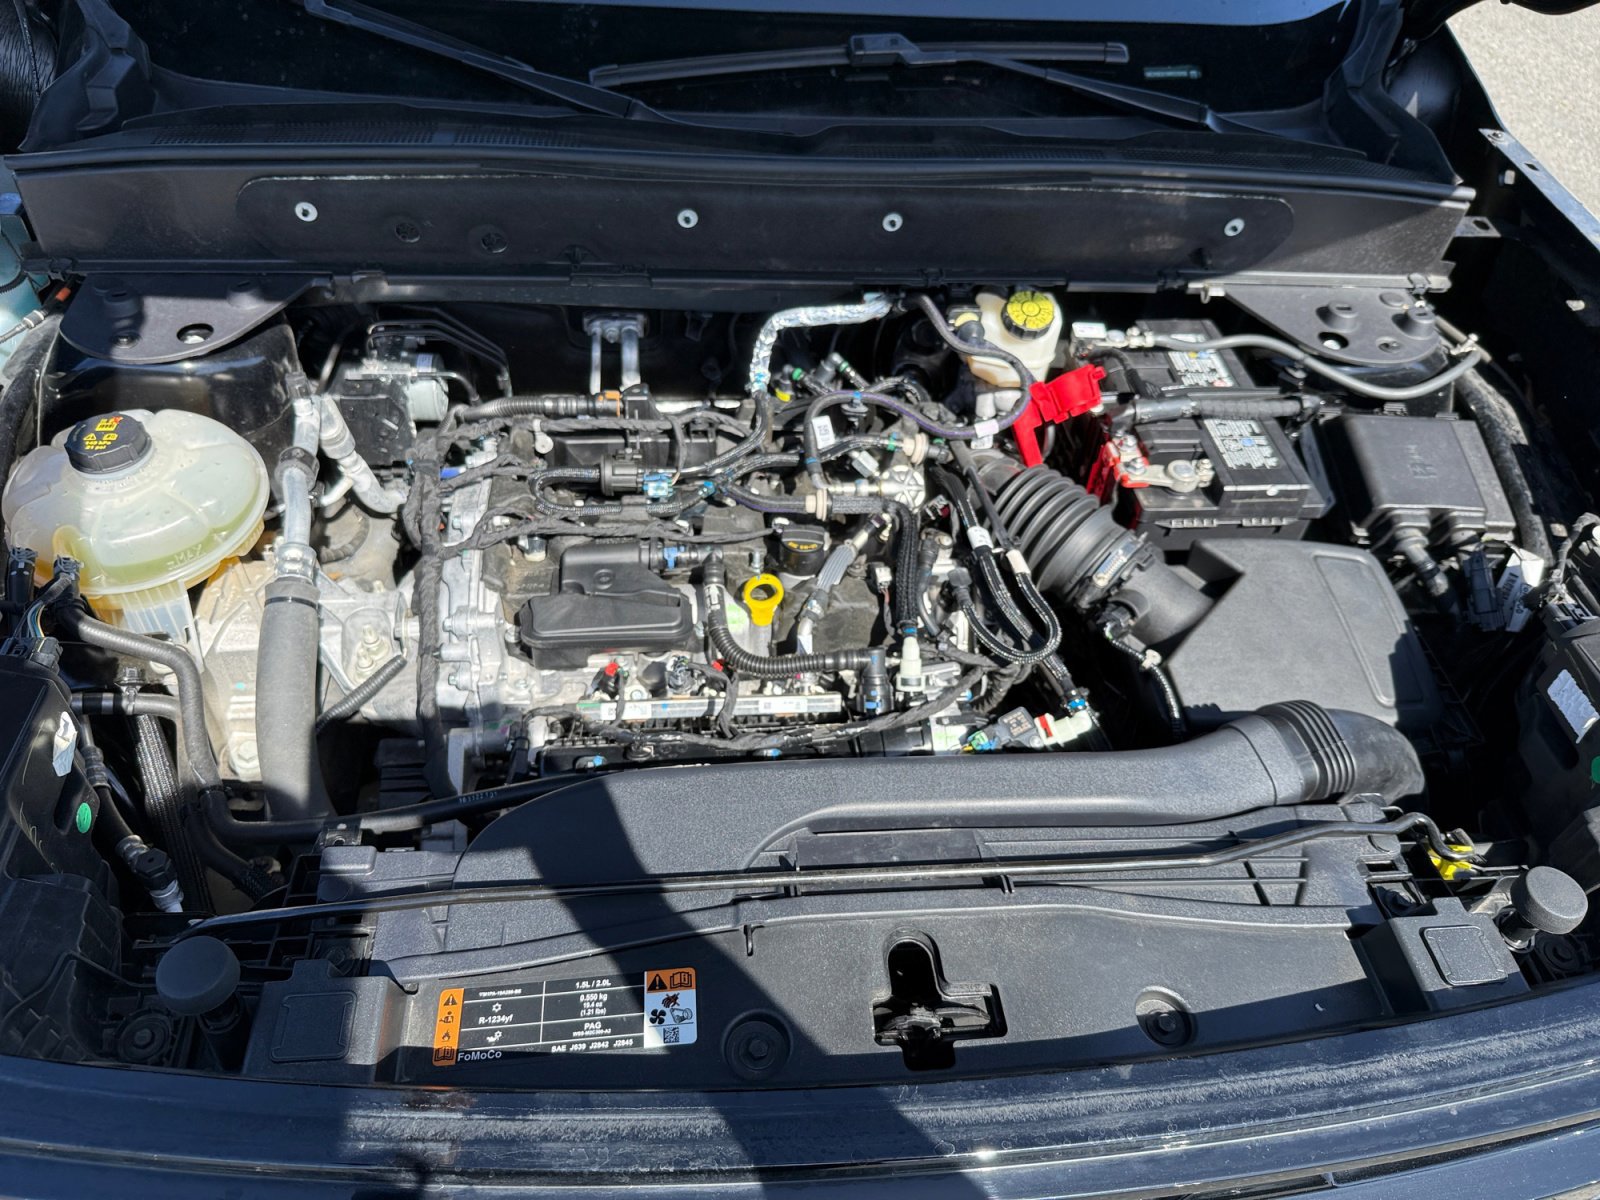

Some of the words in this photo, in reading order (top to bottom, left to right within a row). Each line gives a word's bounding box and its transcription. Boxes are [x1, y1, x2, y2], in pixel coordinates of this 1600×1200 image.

[575, 981, 590, 989] 1.5L
[596, 979, 611, 987] 2.0L
[599, 992, 608, 1002] kg
[478, 1014, 514, 1025] R-1234yf
[584, 1022, 602, 1030] PAG
[551, 1044, 567, 1053] SAE
[569, 1043, 586, 1051] J639
[457, 1049, 502, 1061] FoMoCo
